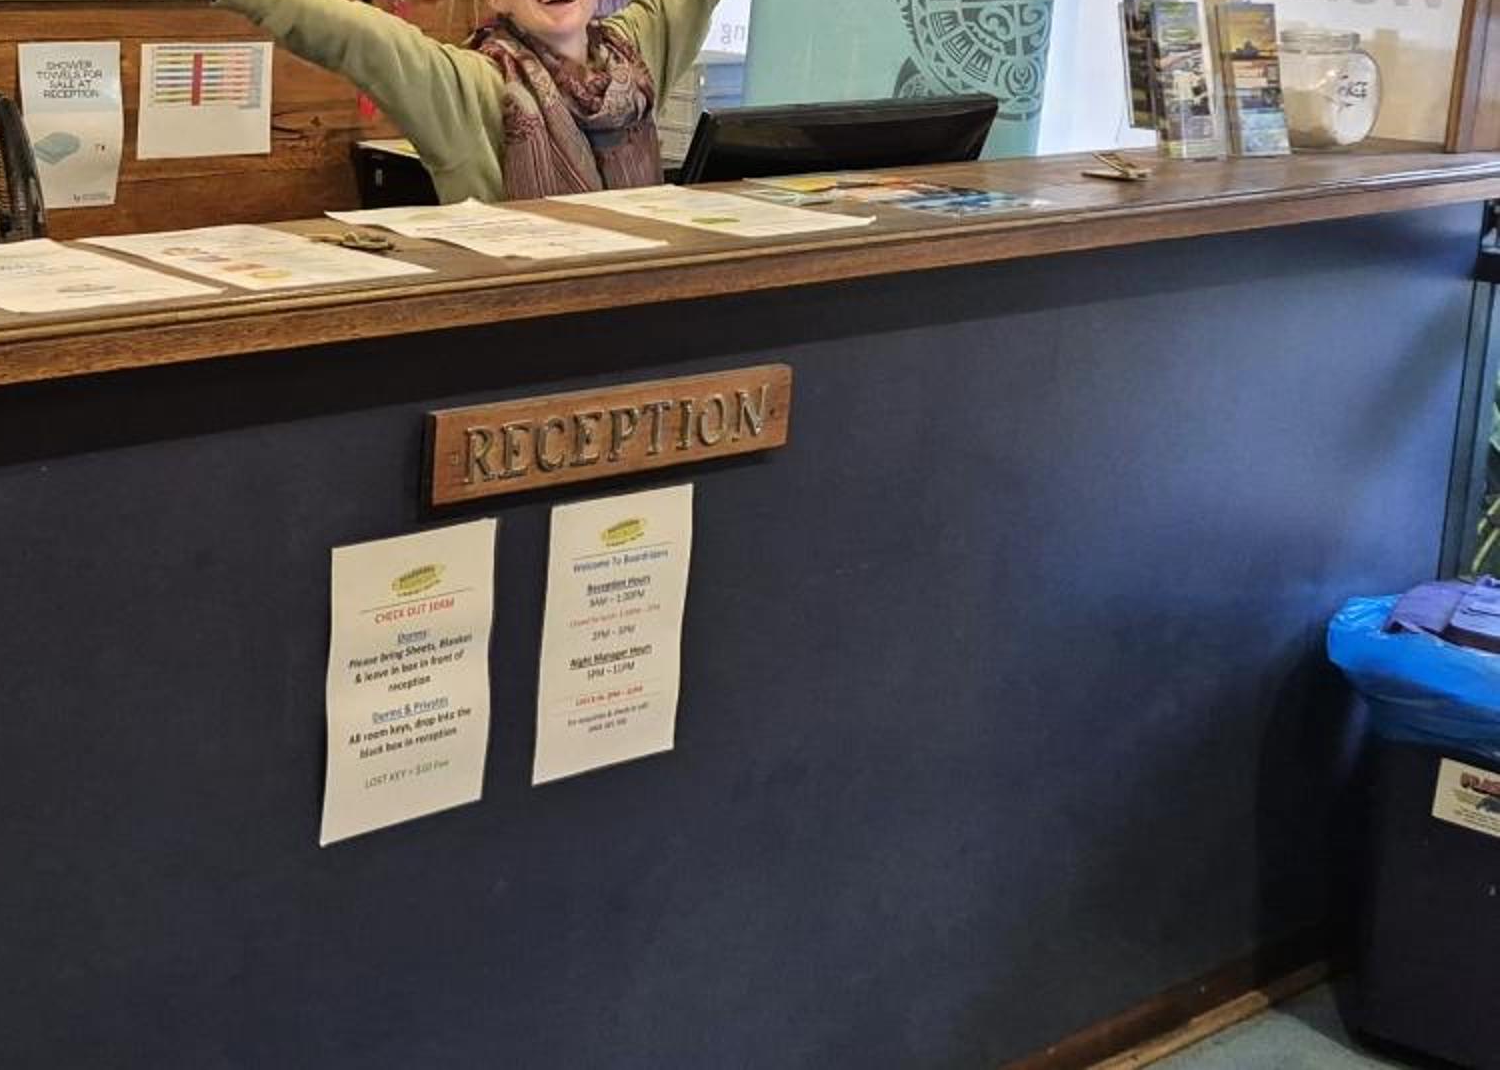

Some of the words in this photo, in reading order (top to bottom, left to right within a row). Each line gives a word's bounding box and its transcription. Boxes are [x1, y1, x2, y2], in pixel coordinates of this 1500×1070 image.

[46, 59, 93, 70] SHOWER
[36, 69, 82, 80] TOWELS
[83, 69, 103, 80] FOR
[49, 79, 75, 89] SALE
[78, 79, 92, 89] AT
[43, 89, 100, 99] RECEPTION
[463, 384, 771, 486] RECEPTION
[374, 607, 405, 624] CHECK
[407, 602, 428, 618] OUT
[349, 655, 379, 669] Please
[355, 673, 362, 684] &
[364, 669, 389, 682] leave
[391, 666, 400, 675] in
[401, 662, 419, 673] box
[420, 659, 429, 668] in
[430, 653, 452, 666] front
[454, 648, 466, 660] of
[388, 675, 431, 692] reception
[404, 703, 411, 715] &
[348, 732, 361, 745] All
[364, 729, 389, 742] room
[390, 723, 413, 736] keys,
[414, 717, 436, 729] drop
[457, 707, 472, 718] the
[360, 744, 384, 759] black
[385, 740, 403, 752] box
[404, 737, 413, 747] in
[415, 726, 457, 743] reception
[364, 773, 388, 789] LOST
[389, 769, 406, 782] KEY
